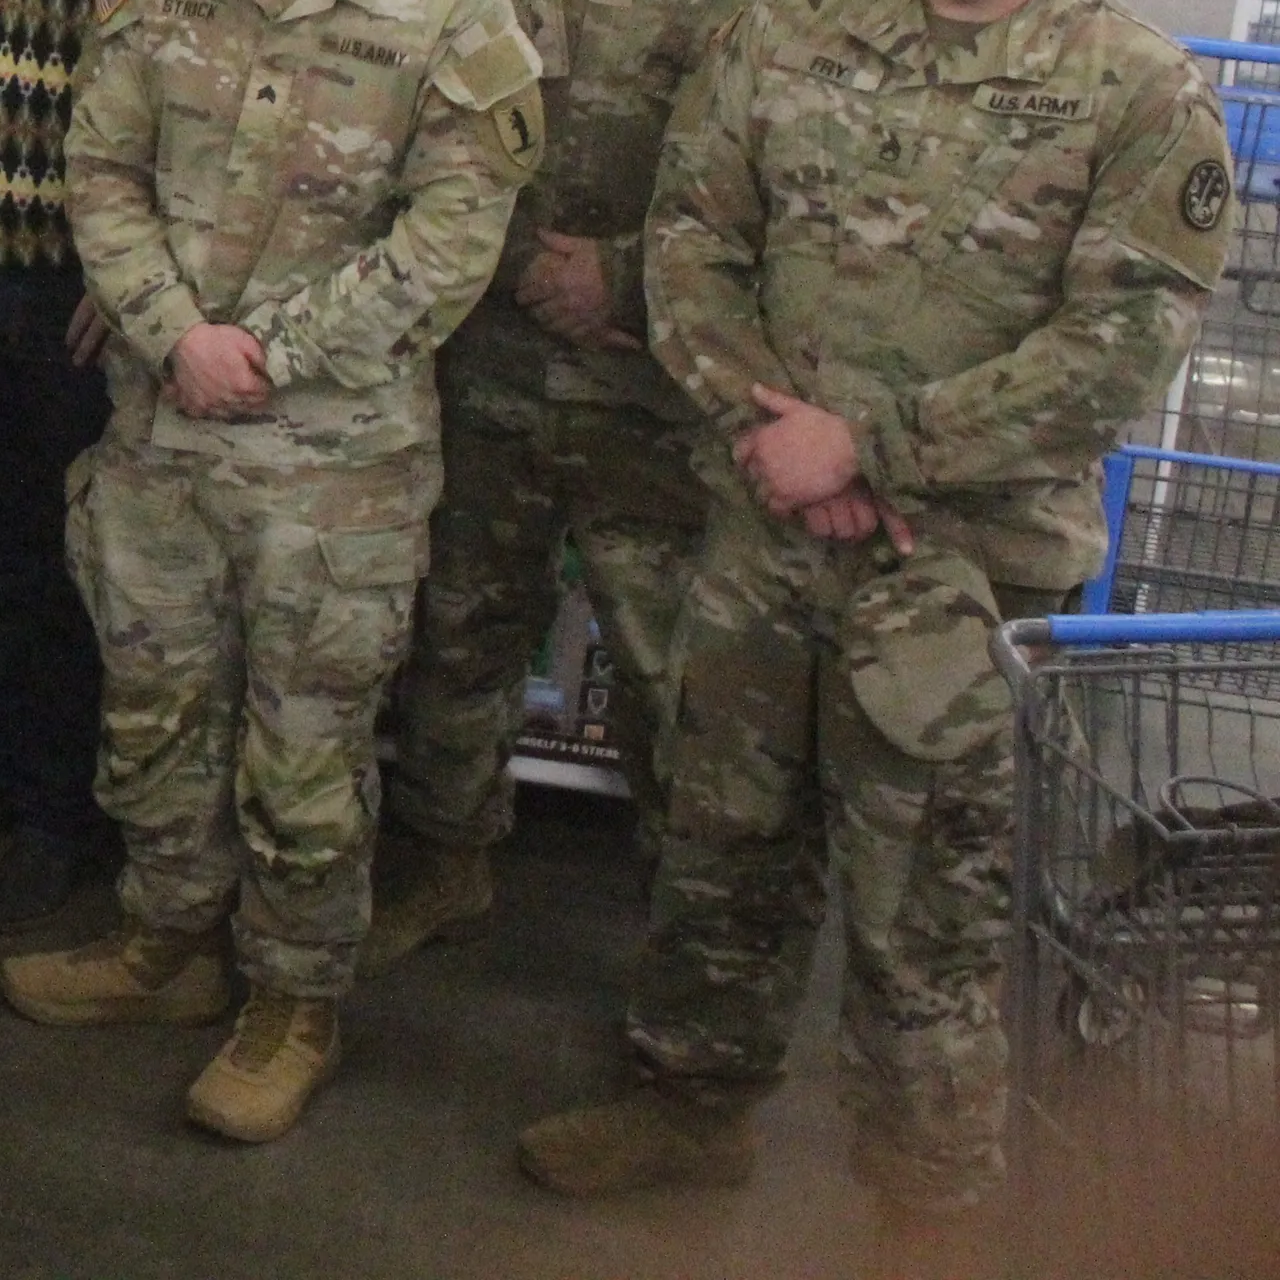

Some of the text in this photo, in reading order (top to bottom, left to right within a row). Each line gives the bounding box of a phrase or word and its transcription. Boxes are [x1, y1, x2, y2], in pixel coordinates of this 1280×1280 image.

[361, 41, 408, 68] ARMY
[809, 55, 849, 78] FRY
[1023, 96, 1081, 118] ARMY
